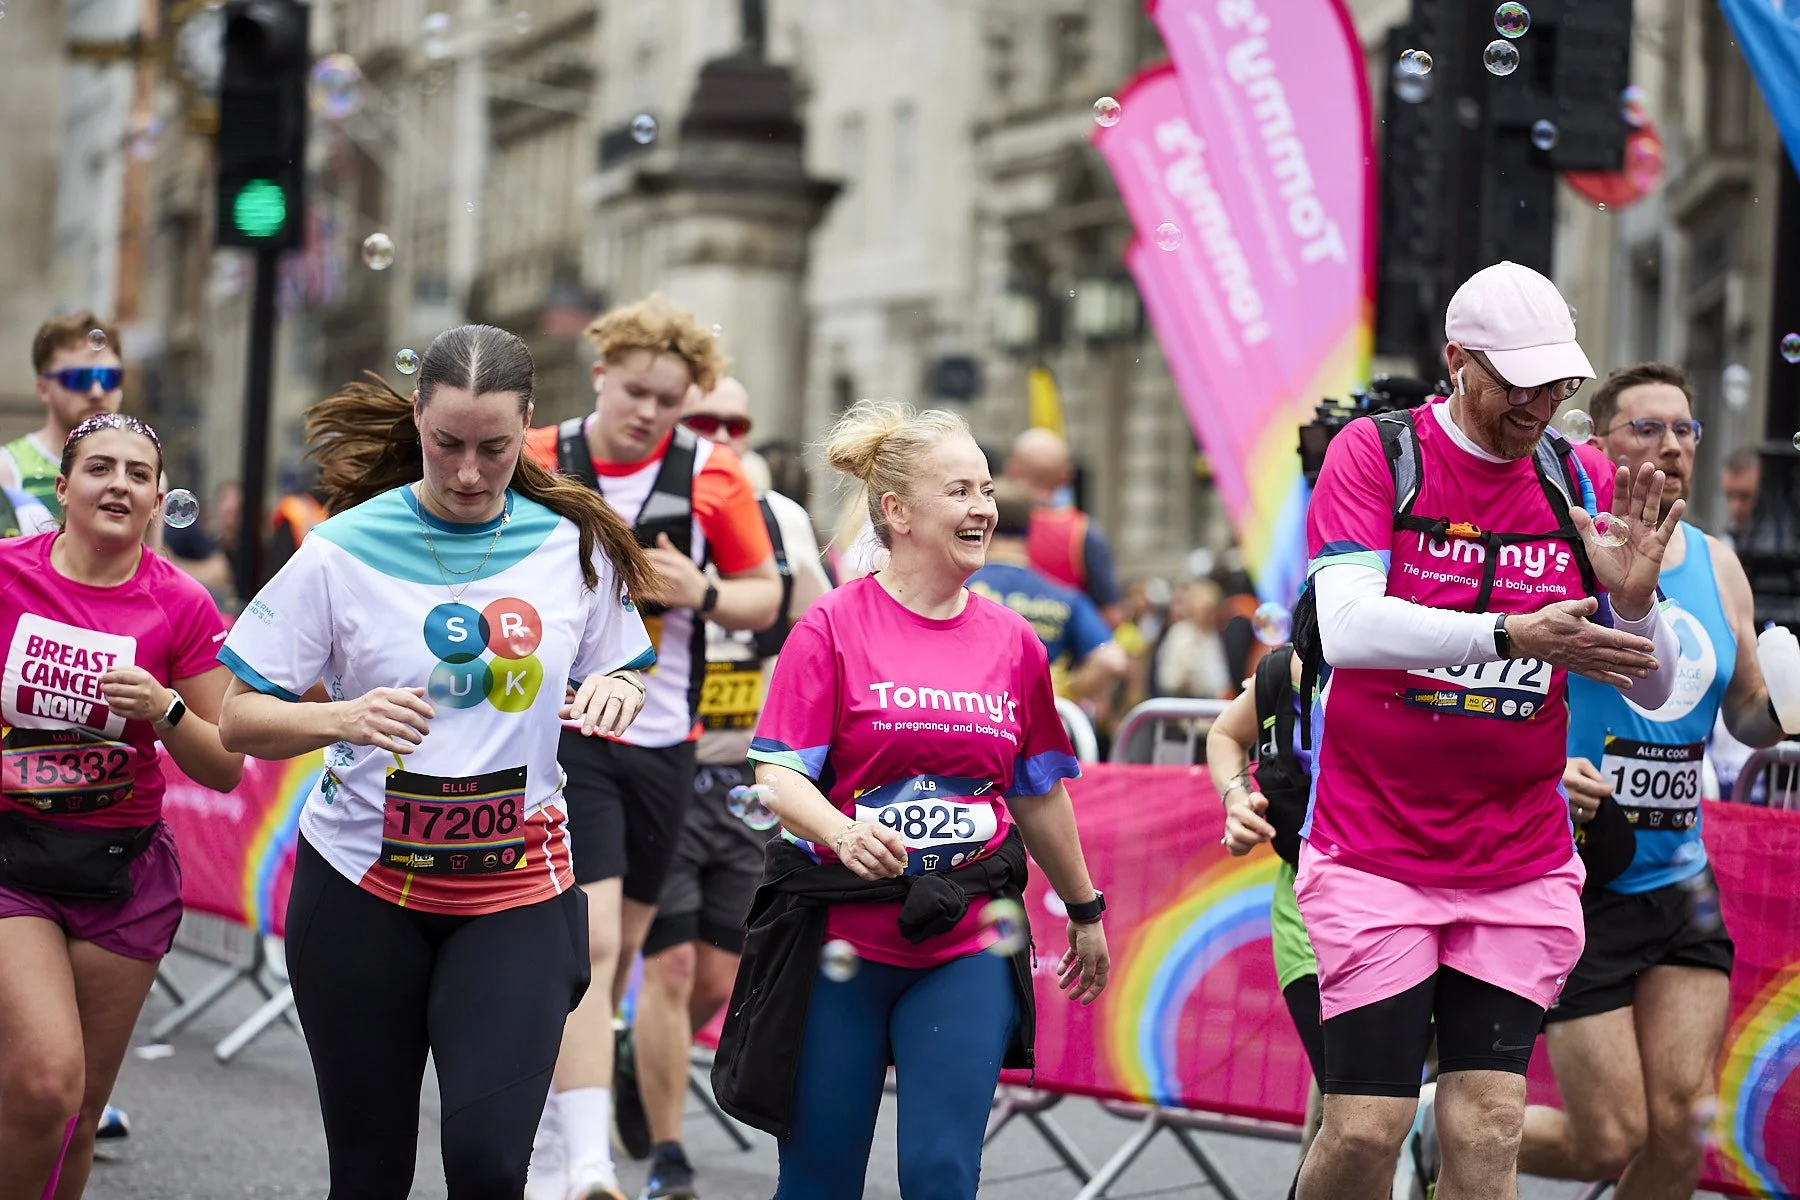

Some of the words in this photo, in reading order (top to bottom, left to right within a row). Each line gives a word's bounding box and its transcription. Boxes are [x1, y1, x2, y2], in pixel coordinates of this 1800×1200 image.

[1403, 562, 1420, 576] The
[1421, 570, 1479, 588] pregnancy
[1505, 578, 1533, 594] baby
[25, 634, 117, 673] BREAST
[32, 690, 93, 724] NOW
[869, 681, 1017, 723] Tommy's
[872, 721, 892, 731] The
[894, 721, 950, 733] pregnancy
[952, 723, 973, 733] and
[975, 723, 999, 738] baby
[13, 749, 130, 785] 15332
[1636, 746, 1664, 757] ALEX
[442, 782, 478, 793] ELLIE
[913, 780, 937, 792] ALB
[1611, 765, 1697, 800] 19063
[395, 798, 518, 840] 17208
[878, 805, 976, 839] 9825
